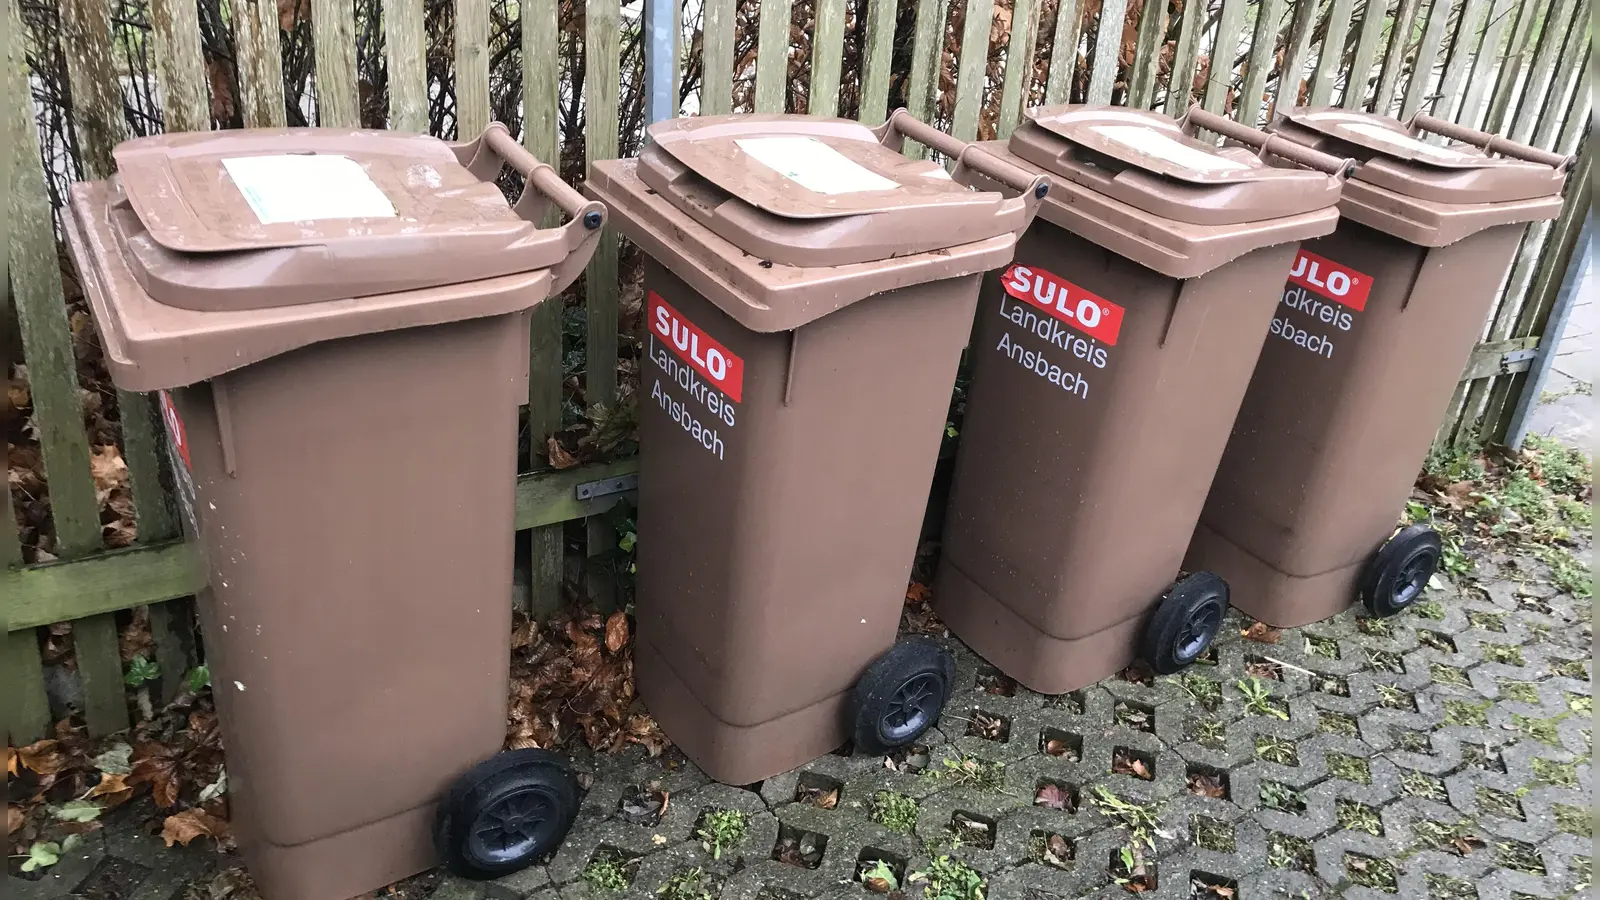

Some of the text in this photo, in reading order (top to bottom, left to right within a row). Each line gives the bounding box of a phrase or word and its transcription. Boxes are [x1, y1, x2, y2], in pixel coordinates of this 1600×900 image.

[996, 332, 1089, 399] Ansbach
[999, 293, 1108, 369] Landkreis
[1270, 318, 1334, 359] sbach
[649, 334, 735, 427] Landkreis
[651, 379, 724, 461] Ansbach
